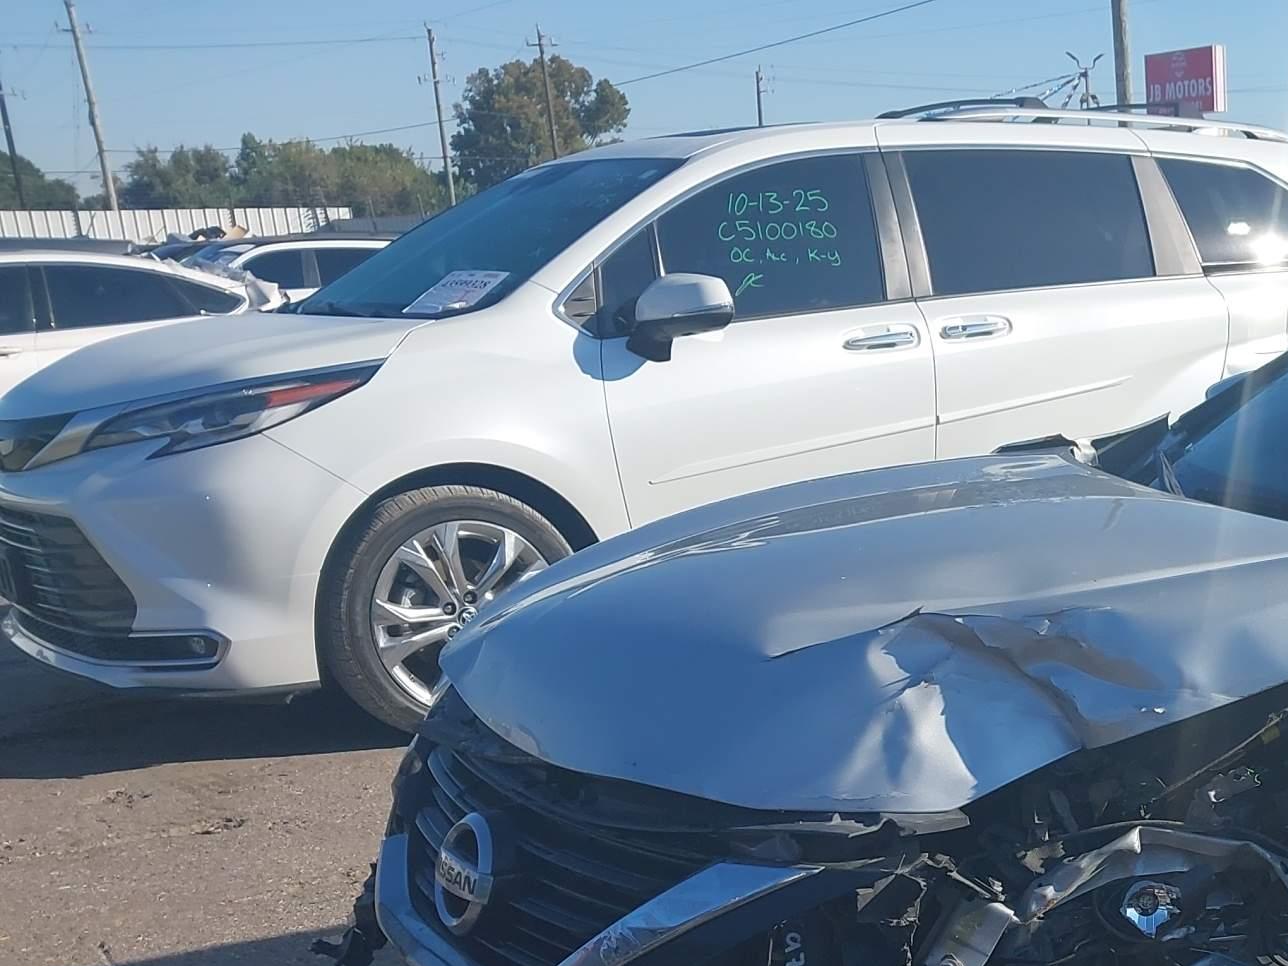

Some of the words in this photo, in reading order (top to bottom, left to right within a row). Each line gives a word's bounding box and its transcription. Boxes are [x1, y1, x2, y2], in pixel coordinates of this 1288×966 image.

[1149, 83, 1161, 103] JB
[1165, 77, 1212, 101] MOTORS
[727, 189, 830, 216] 10-13-25
[718, 220, 838, 242] C5100180
